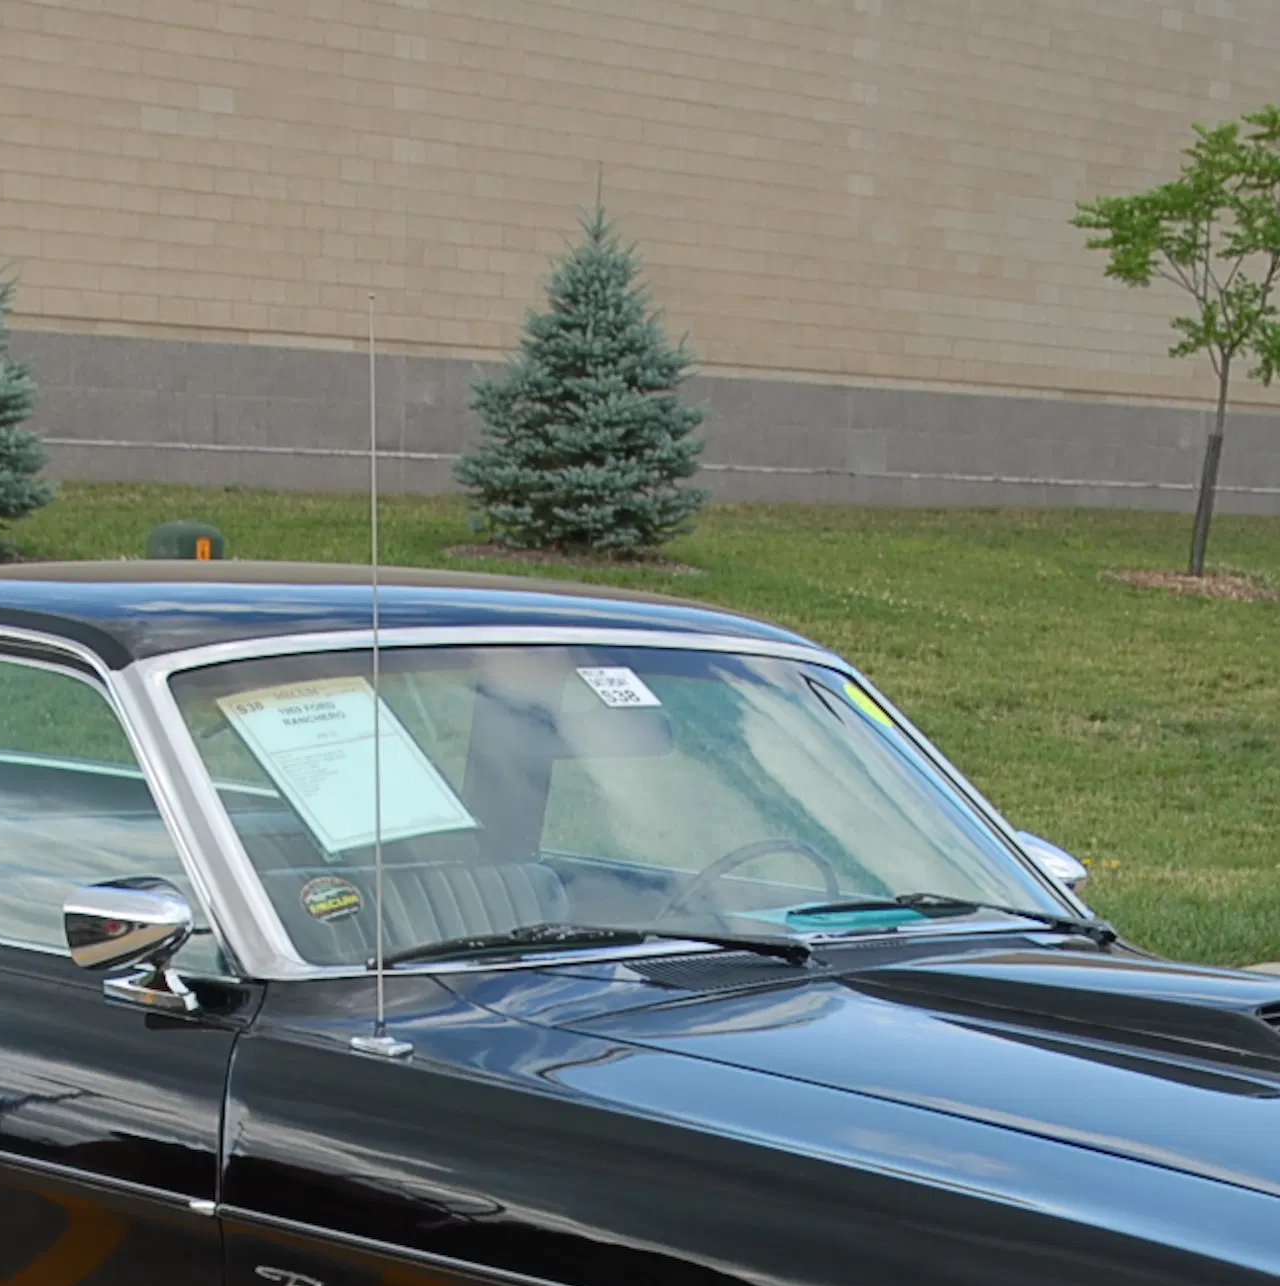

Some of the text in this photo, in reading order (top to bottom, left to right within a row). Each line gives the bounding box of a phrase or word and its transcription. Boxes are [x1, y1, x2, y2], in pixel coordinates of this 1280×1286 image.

[600, 689, 641, 703] S38
[304, 701, 337, 714] FORD
[282, 710, 348, 726] RANCHERO
